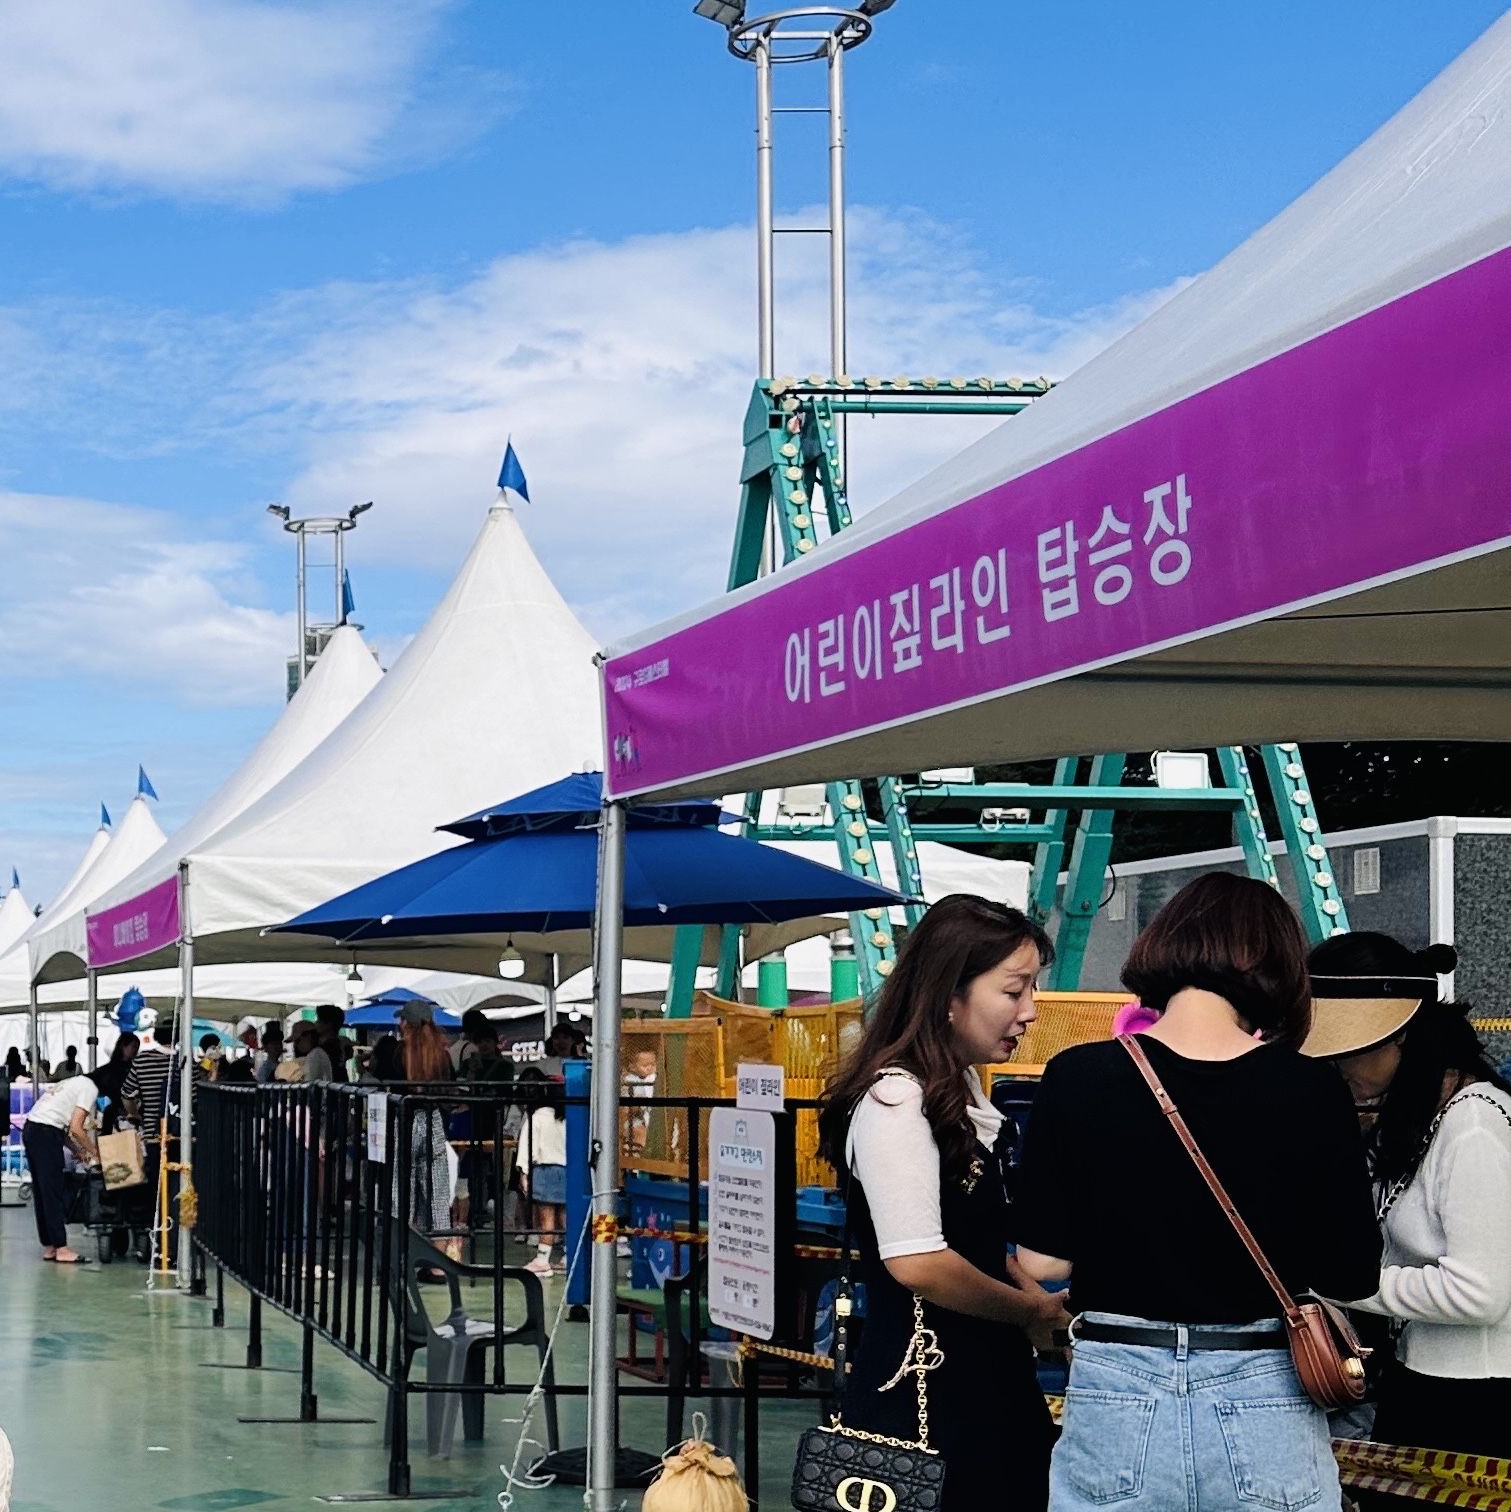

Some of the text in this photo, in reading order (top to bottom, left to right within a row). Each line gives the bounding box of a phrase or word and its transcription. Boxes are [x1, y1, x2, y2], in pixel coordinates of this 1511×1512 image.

[785, 473, 1193, 704] 어린이짚라인 탑승장
[512, 1041, 548, 1062] STEA
